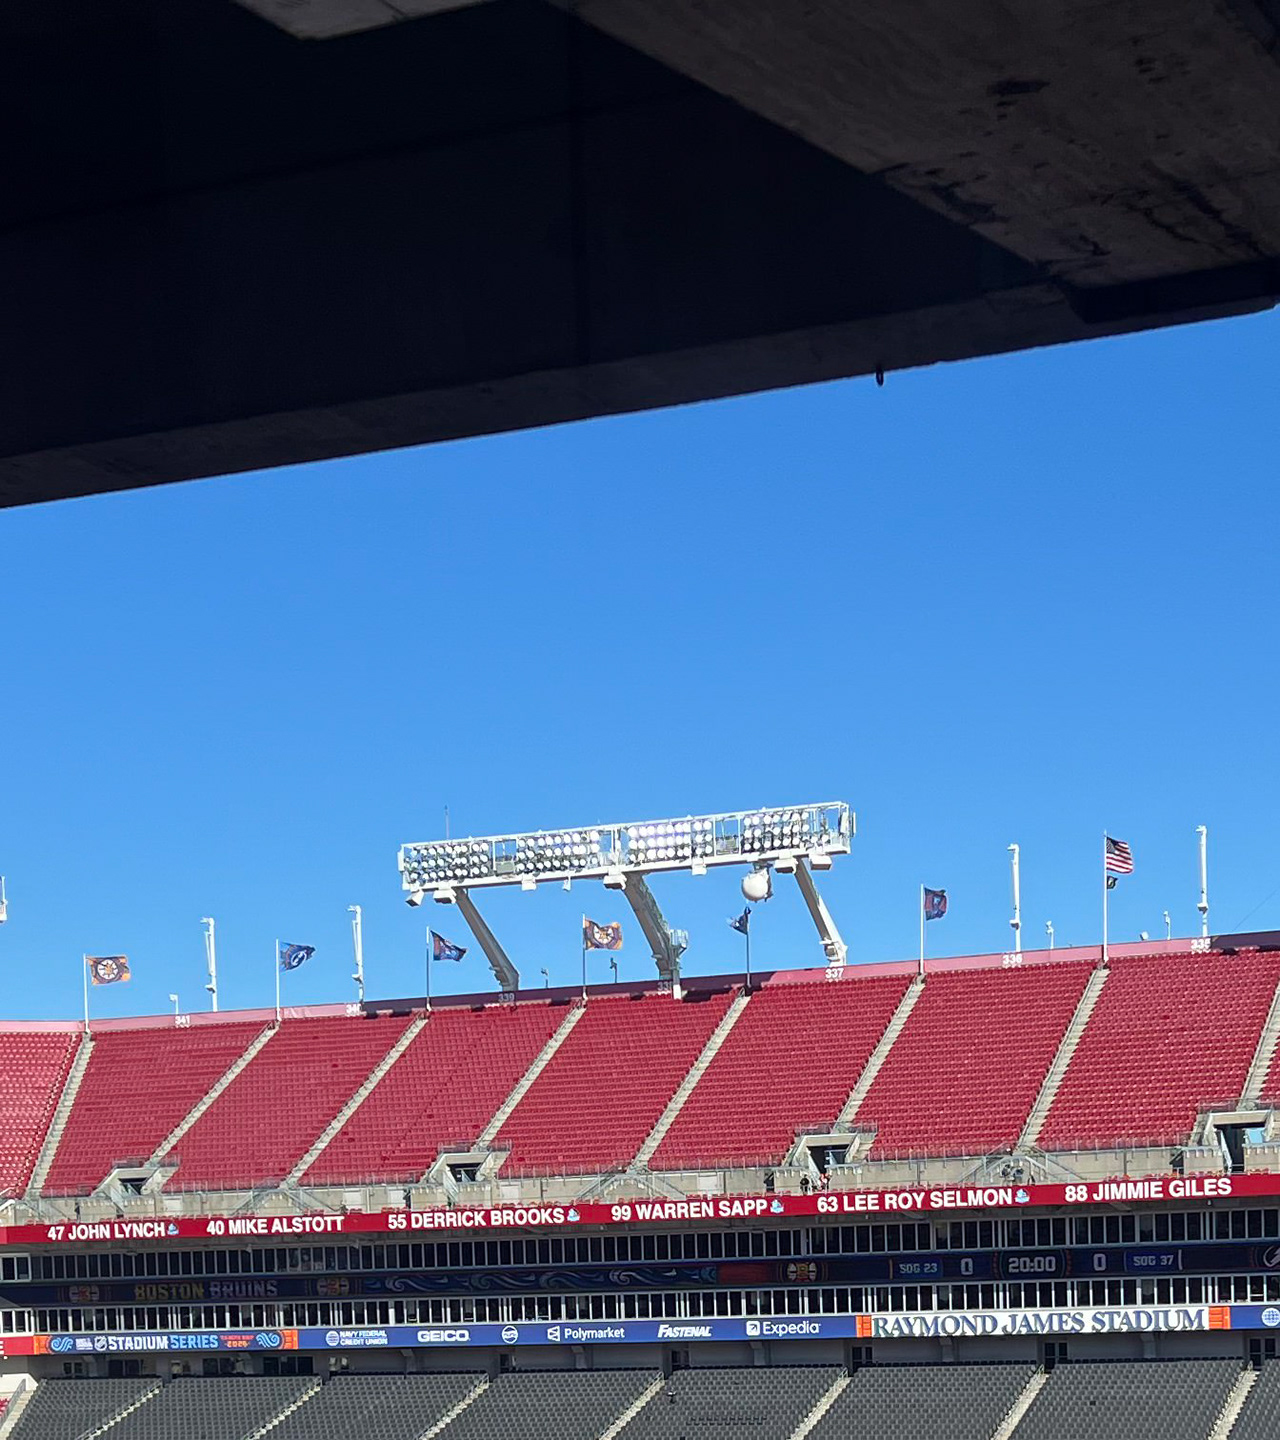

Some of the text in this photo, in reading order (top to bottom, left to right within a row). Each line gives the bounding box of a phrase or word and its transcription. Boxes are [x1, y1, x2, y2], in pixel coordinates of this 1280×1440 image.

[1065, 1178, 1232, 1202] 88 JIMMIE GILES
[611, 1200, 768, 1221] 99 WARREN SAPP
[817, 1189, 1012, 1213] 63 LEE ROY SELMON
[206, 1216, 344, 1235] 40 MIKE ALSTOTT
[388, 1208, 565, 1229] 55 DERRICK BROOKS
[48, 1222, 165, 1241] 47 JOHN LYNCH
[1008, 1257, 1057, 1273] 20:00
[134, 1280, 278, 1299] BOSTON BRUINS
[657, 1324, 713, 1339] FASTENAL
[763, 1320, 820, 1337] Expedia
[873, 1308, 1210, 1337] RAYMOND JAMES STADIUM
[108, 1334, 168, 1351] STADIUM
[170, 1333, 219, 1348] SERIES
[417, 1330, 469, 1342] GEICO
[564, 1327, 625, 1341] Polymarket
